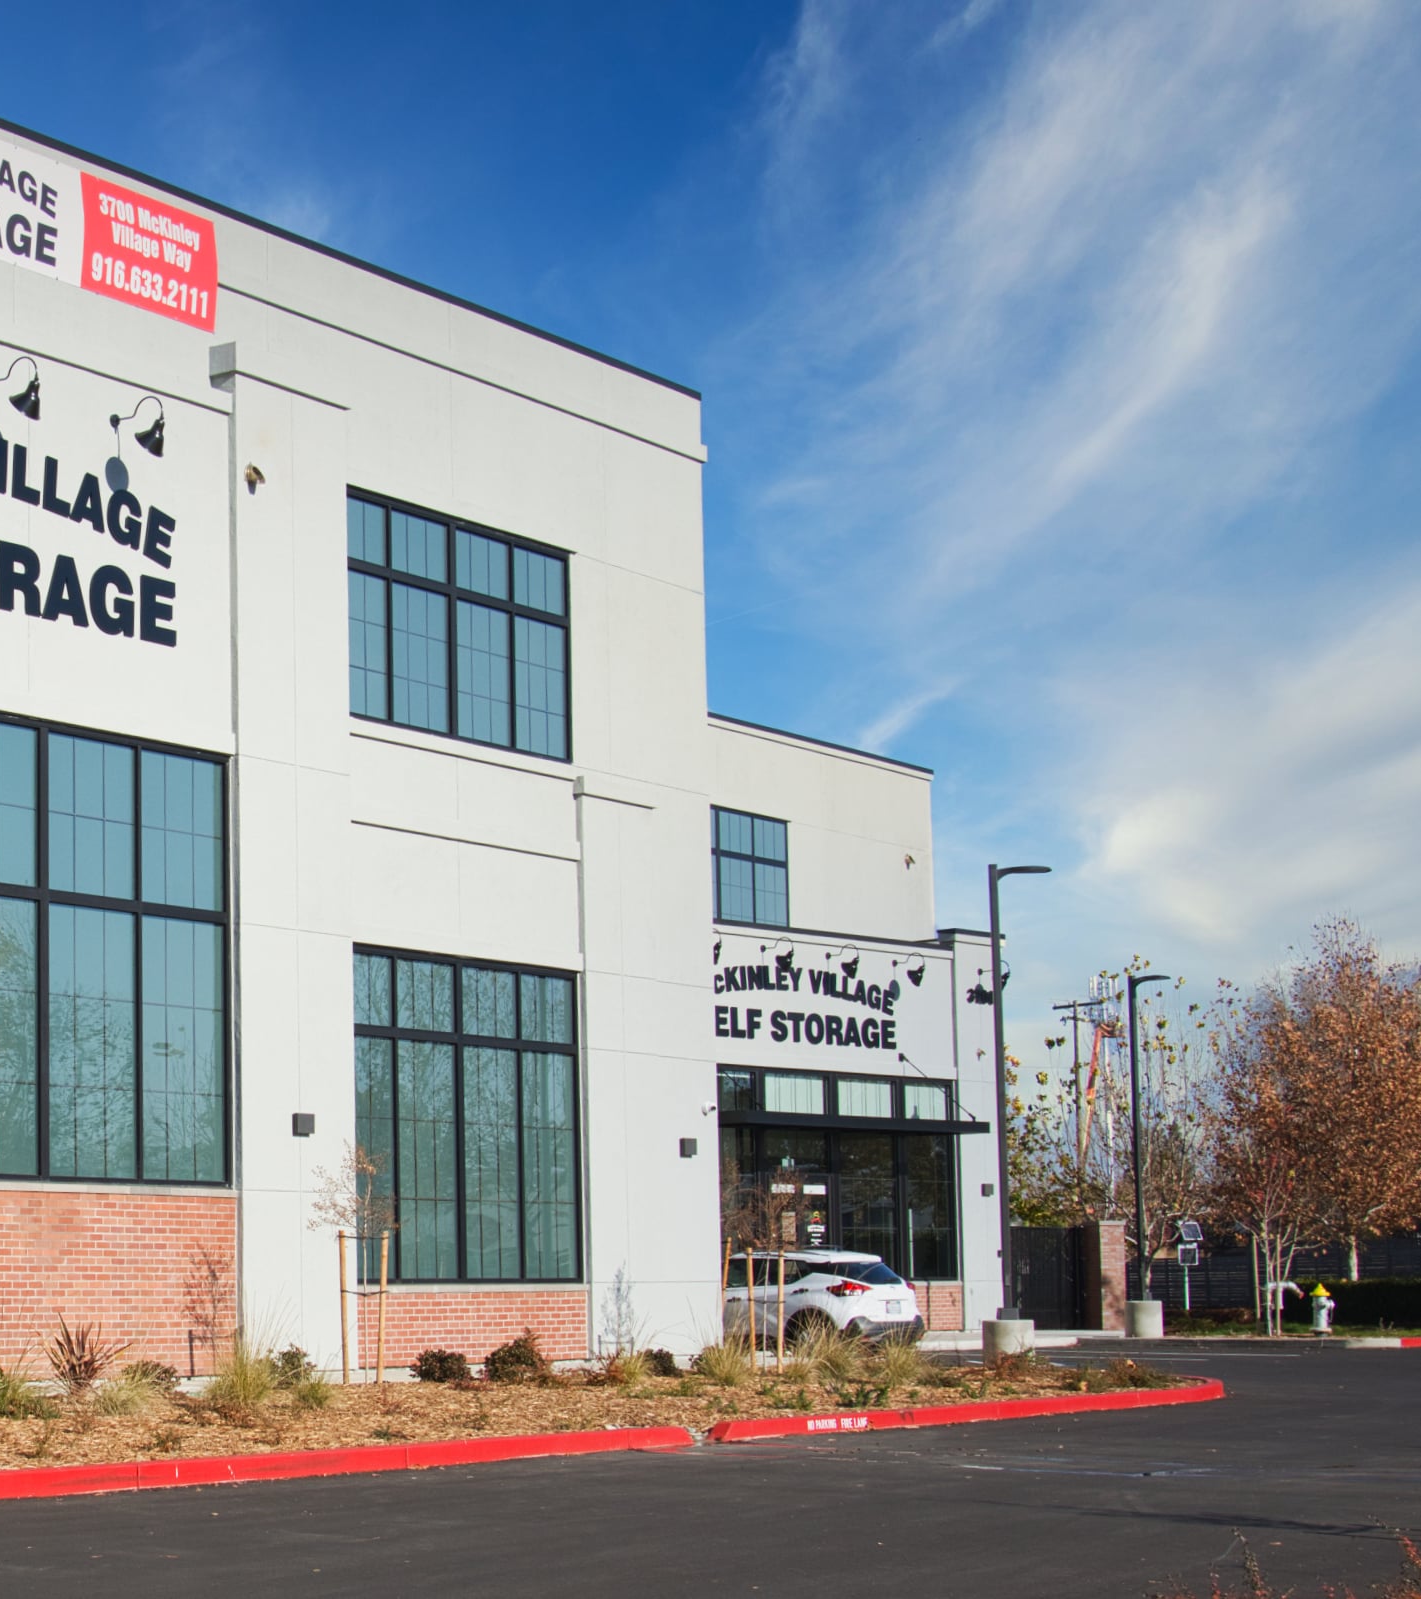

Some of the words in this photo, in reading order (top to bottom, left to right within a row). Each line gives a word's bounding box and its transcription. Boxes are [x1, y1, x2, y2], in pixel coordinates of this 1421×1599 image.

[98, 193, 135, 225] 3700
[137, 207, 200, 252] McKinley
[111, 220, 160, 259] Village
[162, 239, 192, 273] Way
[91, 252, 209, 319] 916.633.2111
[808, 969, 895, 1016] VILLAGE
[770, 1010, 897, 1050] STORAGE
